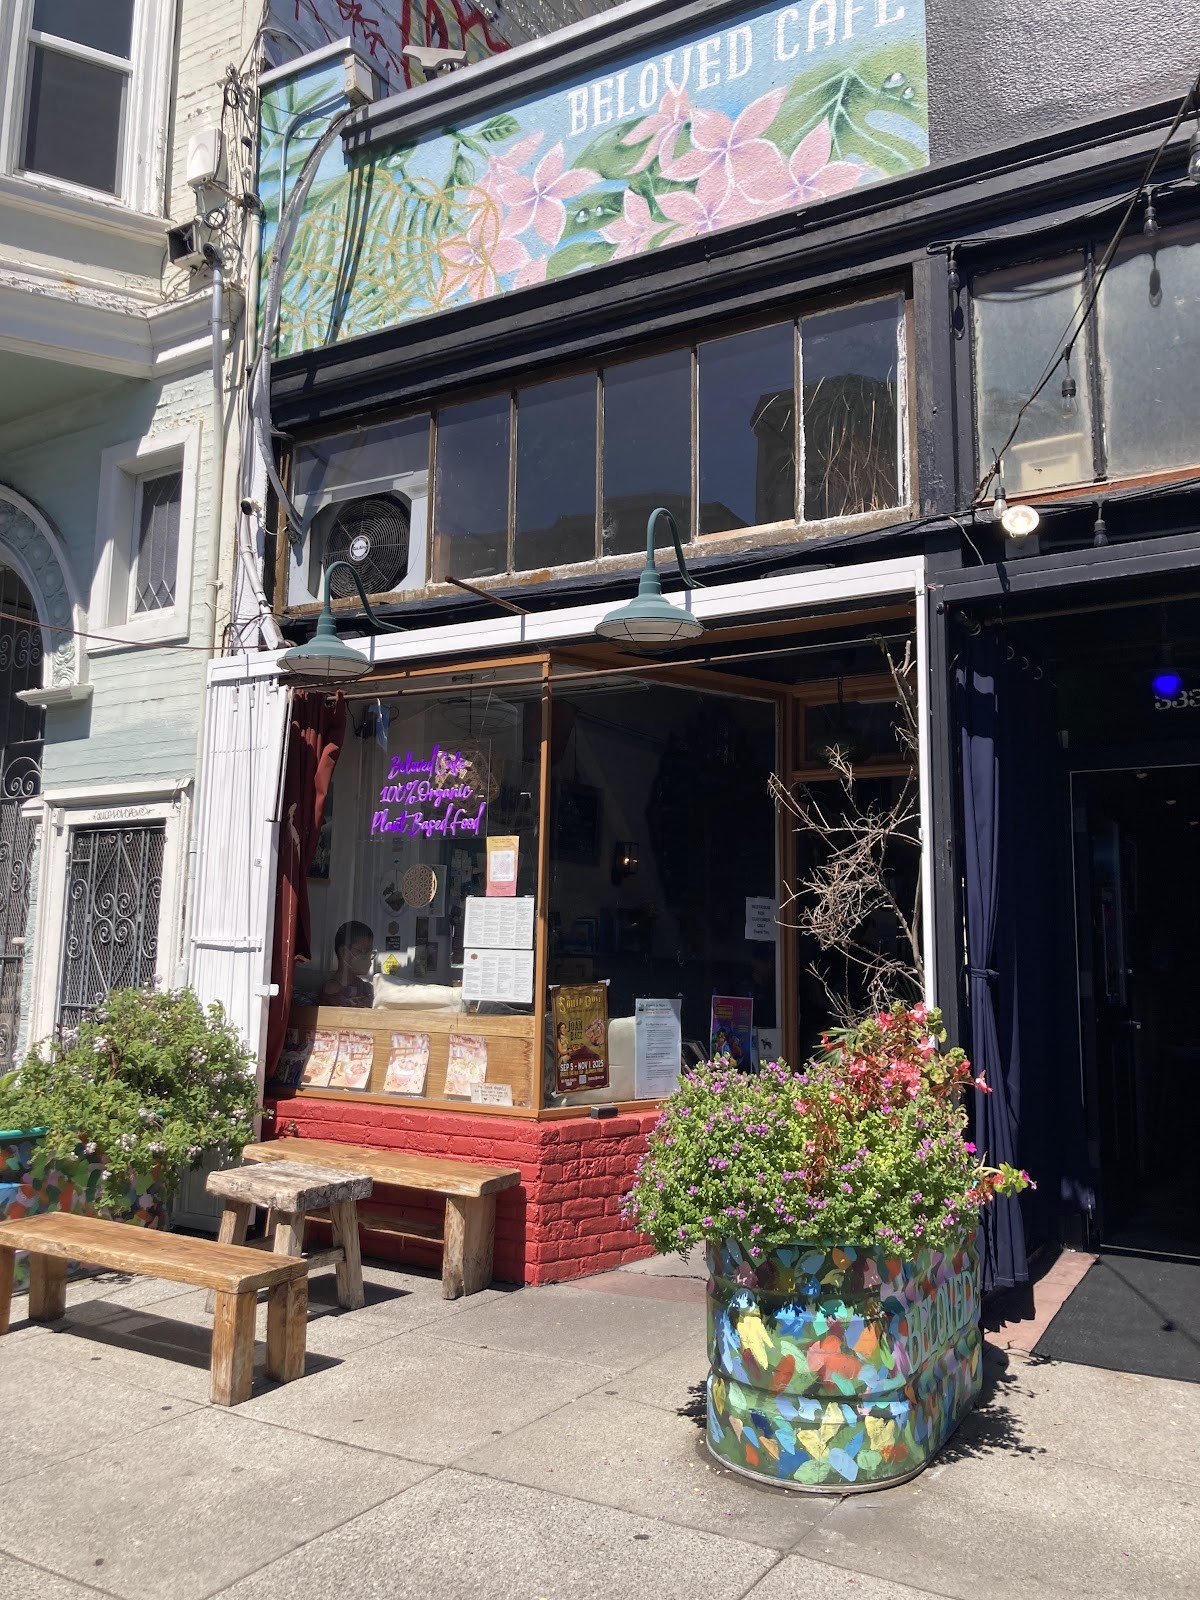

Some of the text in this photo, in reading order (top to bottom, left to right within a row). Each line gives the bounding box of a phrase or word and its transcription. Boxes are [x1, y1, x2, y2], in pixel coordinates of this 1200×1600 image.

[567, 25, 753, 137] BELOVED
[773, 0, 906, 62] CAFE
[387, 743, 440, 780] Beloved
[379, 779, 473, 807] 100% Organic
[370, 808, 413, 836] Plant
[408, 803, 454, 837] Based
[560, 1063, 570, 1072] SEP
[570, 1063, 574, 1071] 5
[578, 1061, 588, 1071] NOV
[592, 1060, 604, 1069] 2025
[905, 1270, 975, 1374] BELOVED
